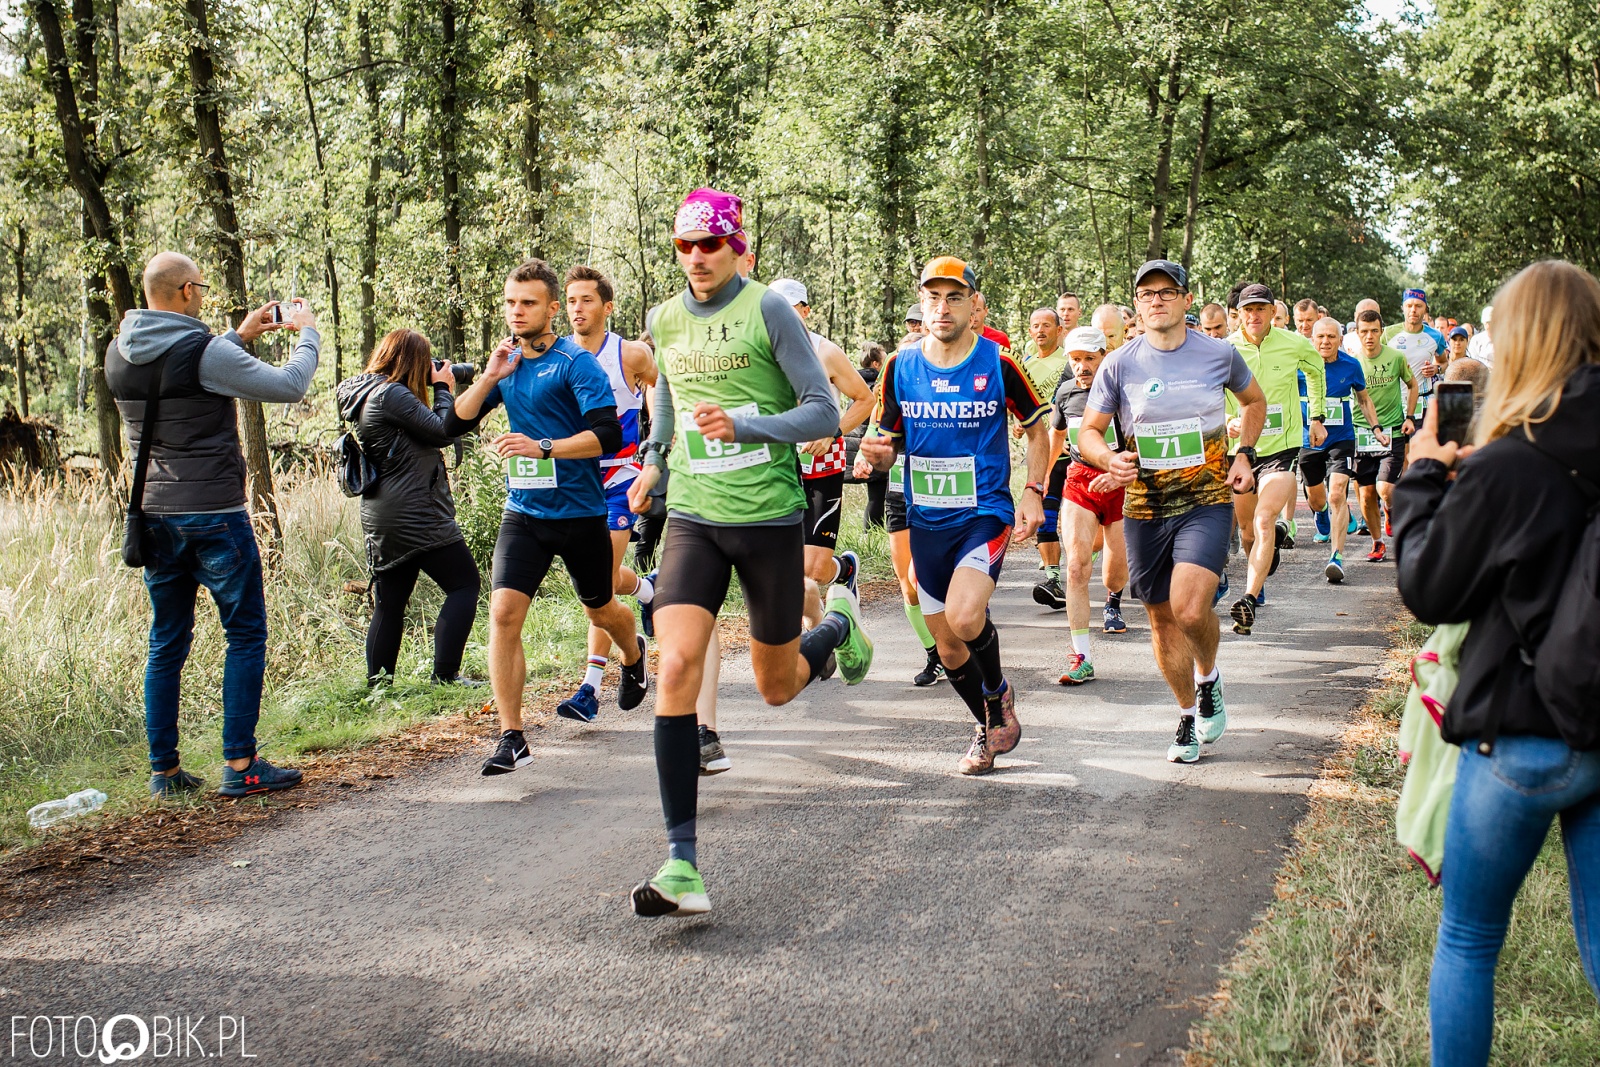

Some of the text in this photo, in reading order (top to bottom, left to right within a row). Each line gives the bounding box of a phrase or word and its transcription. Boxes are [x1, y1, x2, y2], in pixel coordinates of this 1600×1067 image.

[696, 373, 728, 383] biegu
[900, 400, 998, 419] RUNNERS
[913, 421, 955, 429] EKO-OKNA
[1156, 436, 1181, 458] 71
[516, 456, 538, 476] 63
[924, 474, 957, 495] 171
